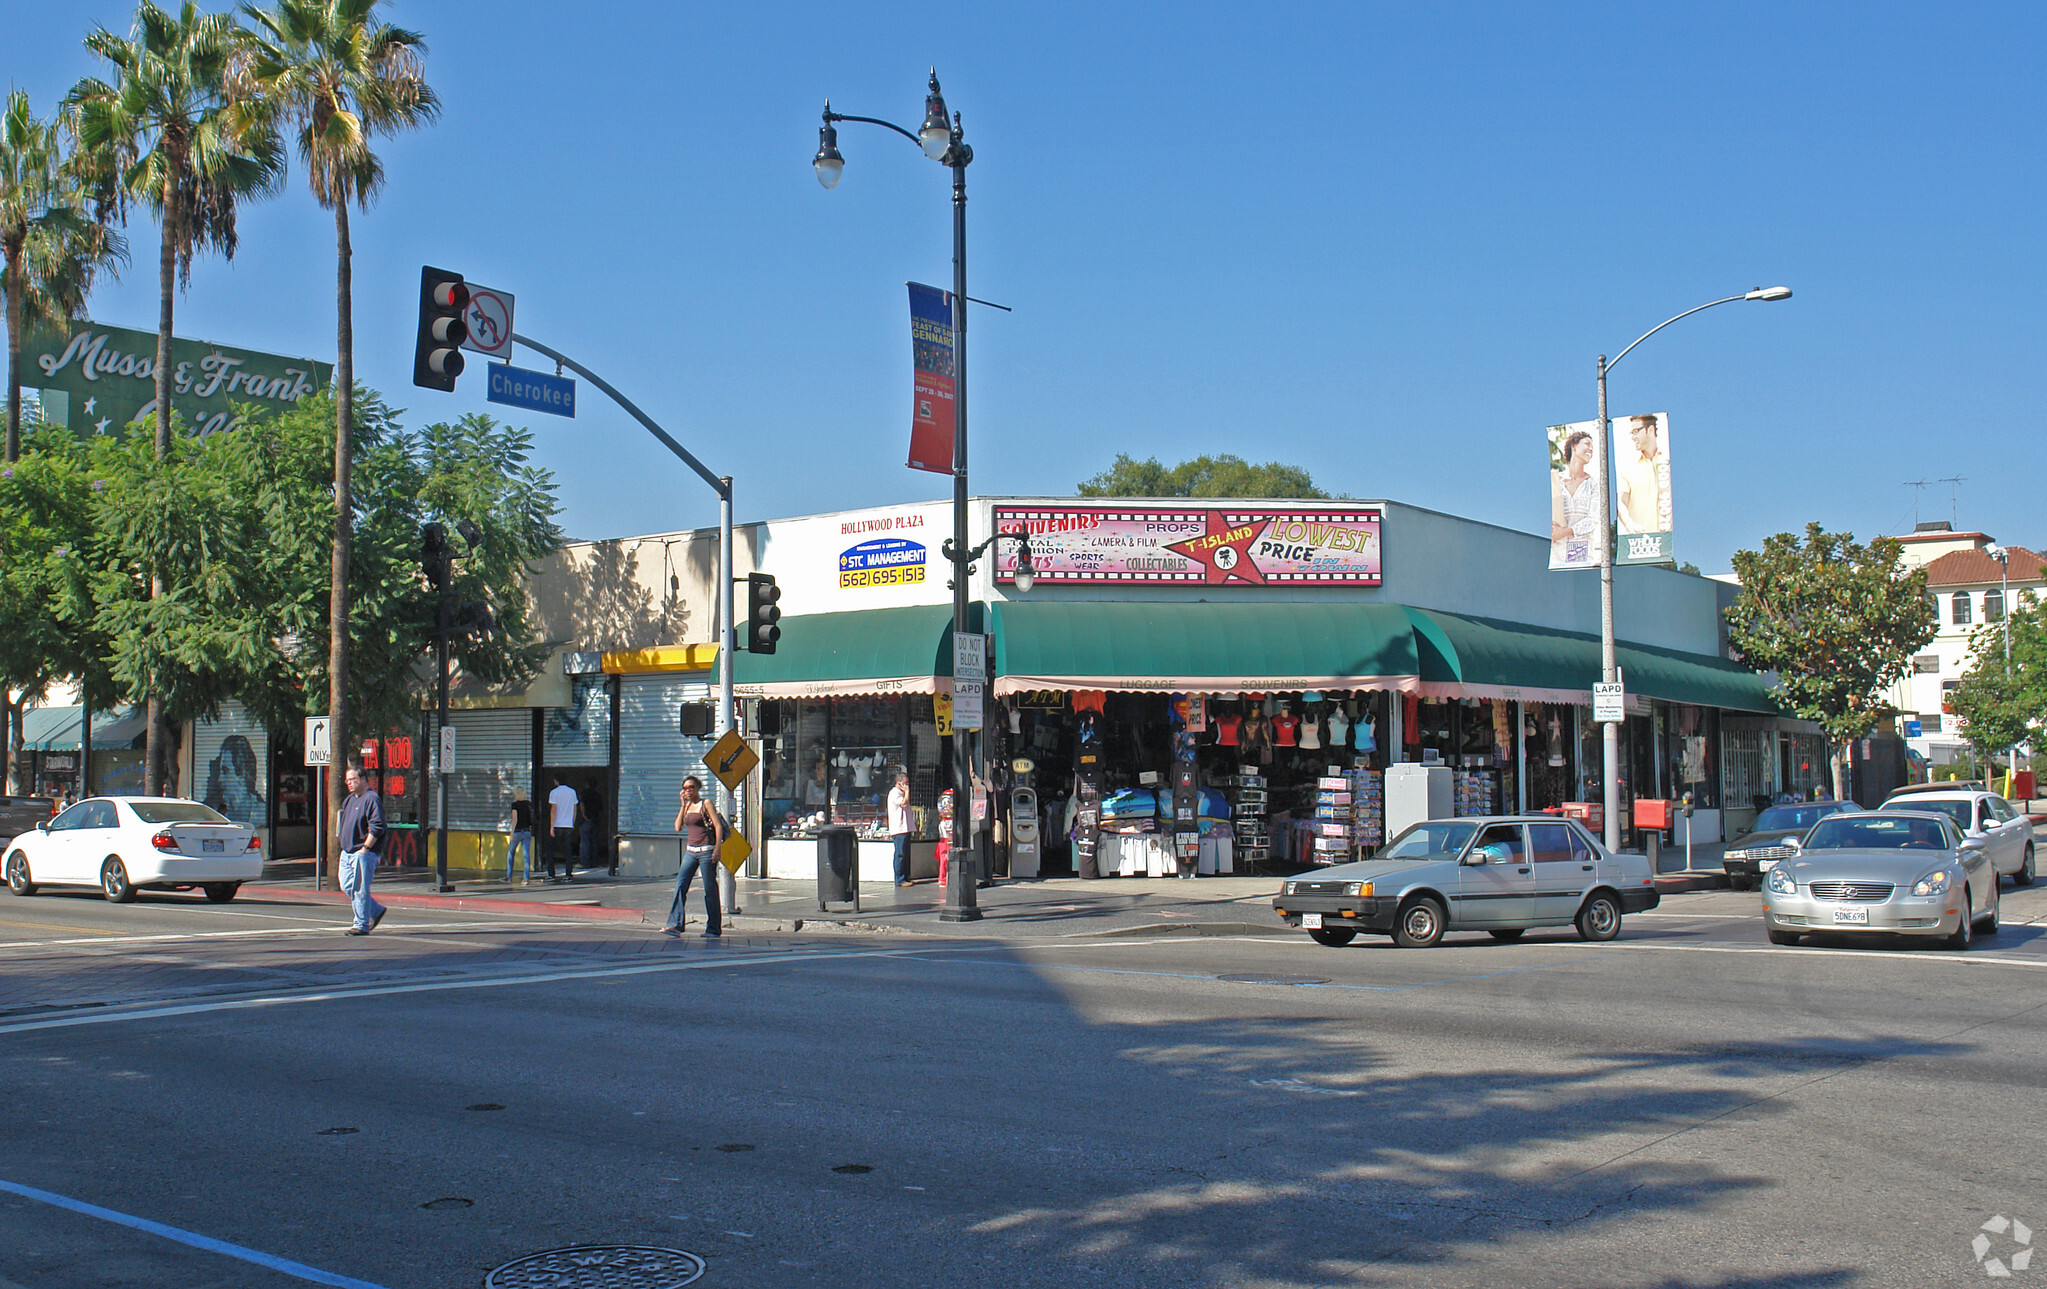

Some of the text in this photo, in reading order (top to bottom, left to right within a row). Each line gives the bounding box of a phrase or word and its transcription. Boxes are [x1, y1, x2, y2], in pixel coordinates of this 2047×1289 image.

[912, 321, 932, 332] FEAST
[912, 328, 953, 348] GENNARO
[194, 351, 313, 401] Frank
[492, 373, 572, 407] Cherokee
[841, 515, 924, 535] HOLLYWOOD PLAZA
[1146, 523, 1200, 533] PROPS
[1184, 526, 1253, 553] T-ISLAND
[1270, 517, 1372, 554] LOWEST
[1091, 537, 1158, 548] CAMERA & FILM
[1628, 536, 1662, 548] WHOLE
[1260, 541, 1316, 562] PRICE
[1630, 545, 1660, 556] FOODS
[848, 549, 925, 568] STC MANAGEMENT
[1070, 553, 1104, 562] SPORTS
[1074, 562, 1100, 570] WEAR
[1126, 557, 1188, 571] COLLECTABLES
[959, 637, 981, 652] DO NOT
[960, 652, 980, 667] BLOCK
[876, 680, 903, 690] GIFTS
[954, 684, 981, 694] LAPD
[1119, 680, 1176, 689] LUGGAGE
[1241, 679, 1308, 689] SOUVENIRS
[1595, 685, 1622, 693] LAPD
[310, 750, 328, 761] ONLY
[362, 736, 412, 769] TATOO
[1015, 761, 1030, 769] ATM
[528, 1255, 663, 1283] SEWER
